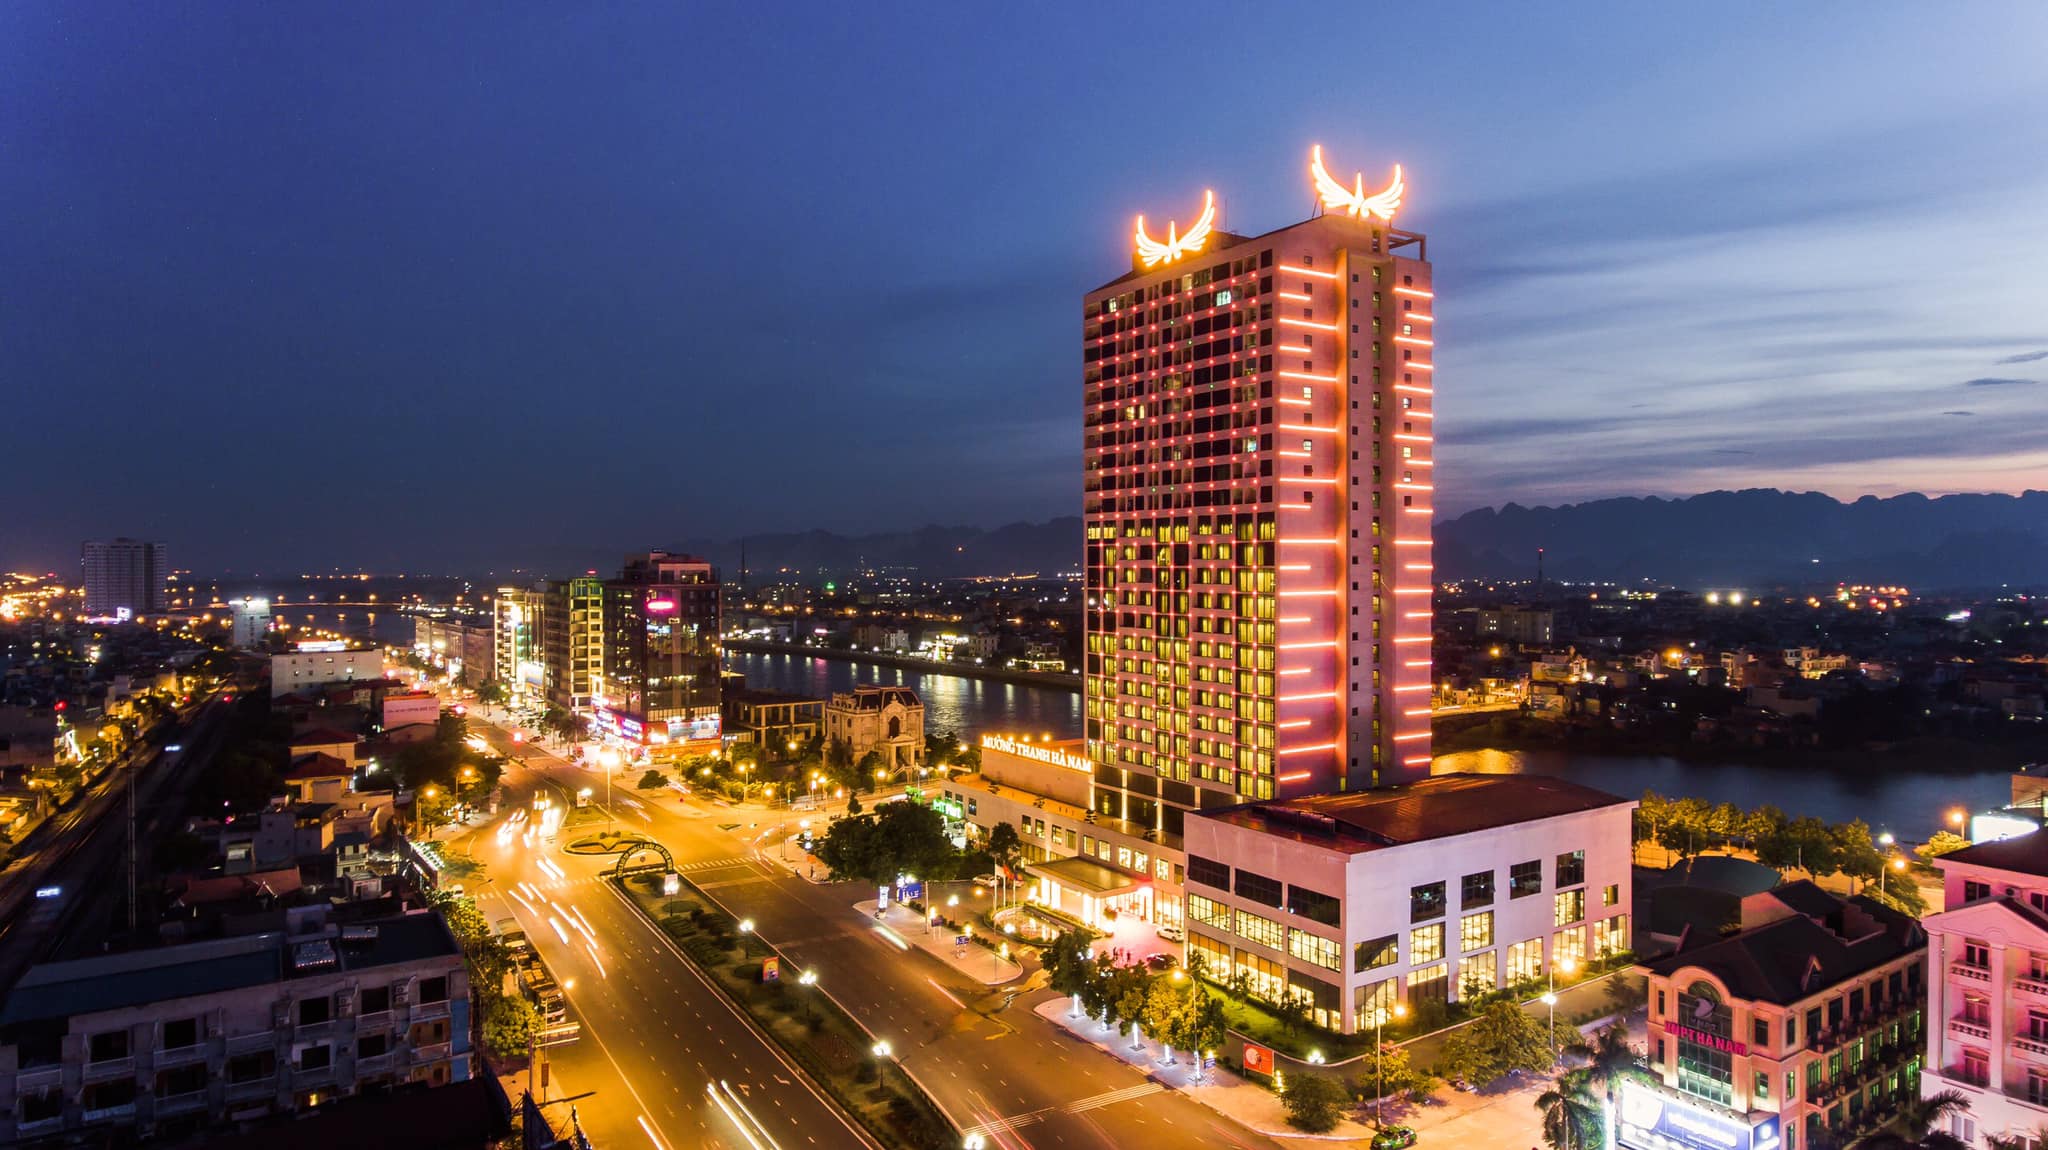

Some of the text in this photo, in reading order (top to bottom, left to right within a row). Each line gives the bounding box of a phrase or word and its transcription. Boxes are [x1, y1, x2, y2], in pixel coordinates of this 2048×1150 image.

[1016, 742, 1050, 763] THANH
[1051, 748, 1066, 767] HÀ
[1067, 754, 1092, 773] NAM
[1715, 1037, 1747, 1056] NAM
